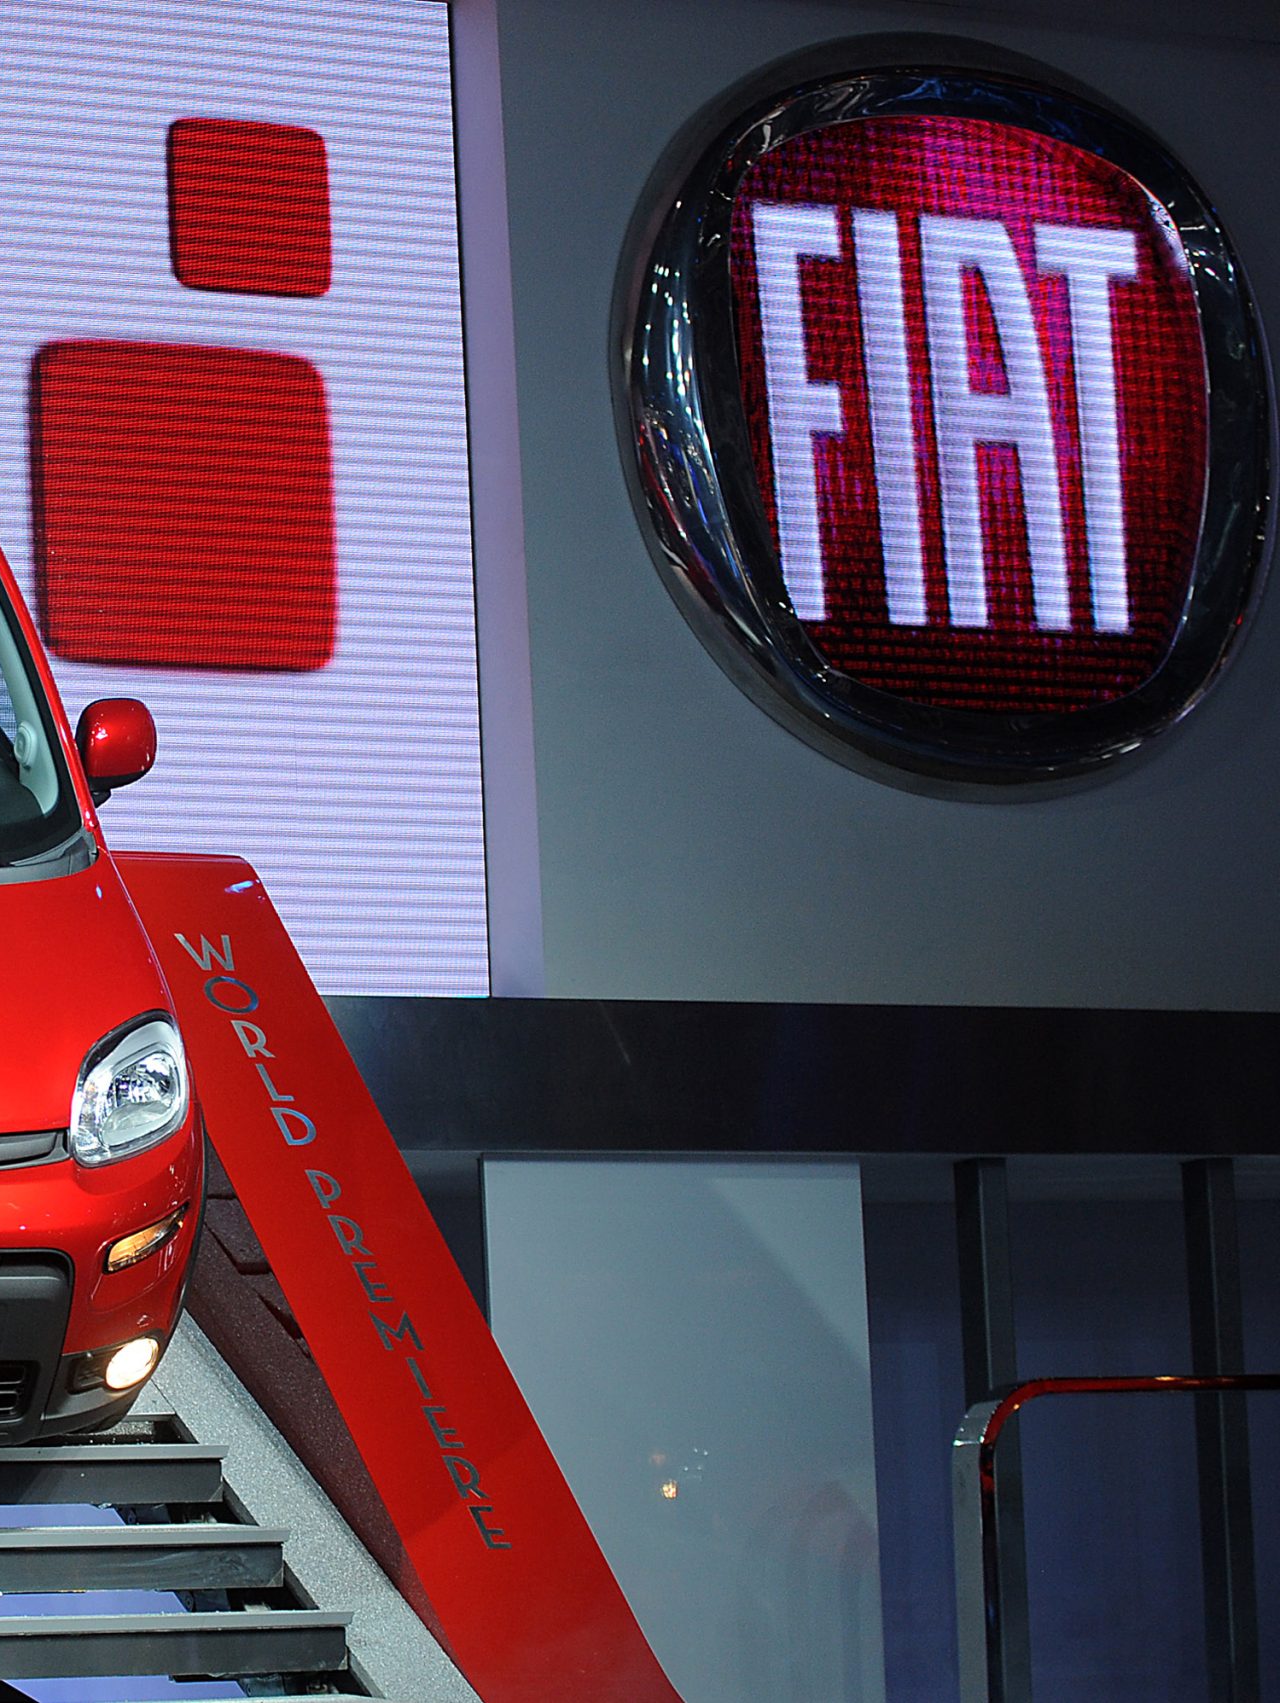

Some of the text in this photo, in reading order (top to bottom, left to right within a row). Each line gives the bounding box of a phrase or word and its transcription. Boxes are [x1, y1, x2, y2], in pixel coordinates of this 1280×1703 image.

[749, 201, 1139, 636] FIAT
[174, 932, 512, 1550] WORLD PREMIERE
